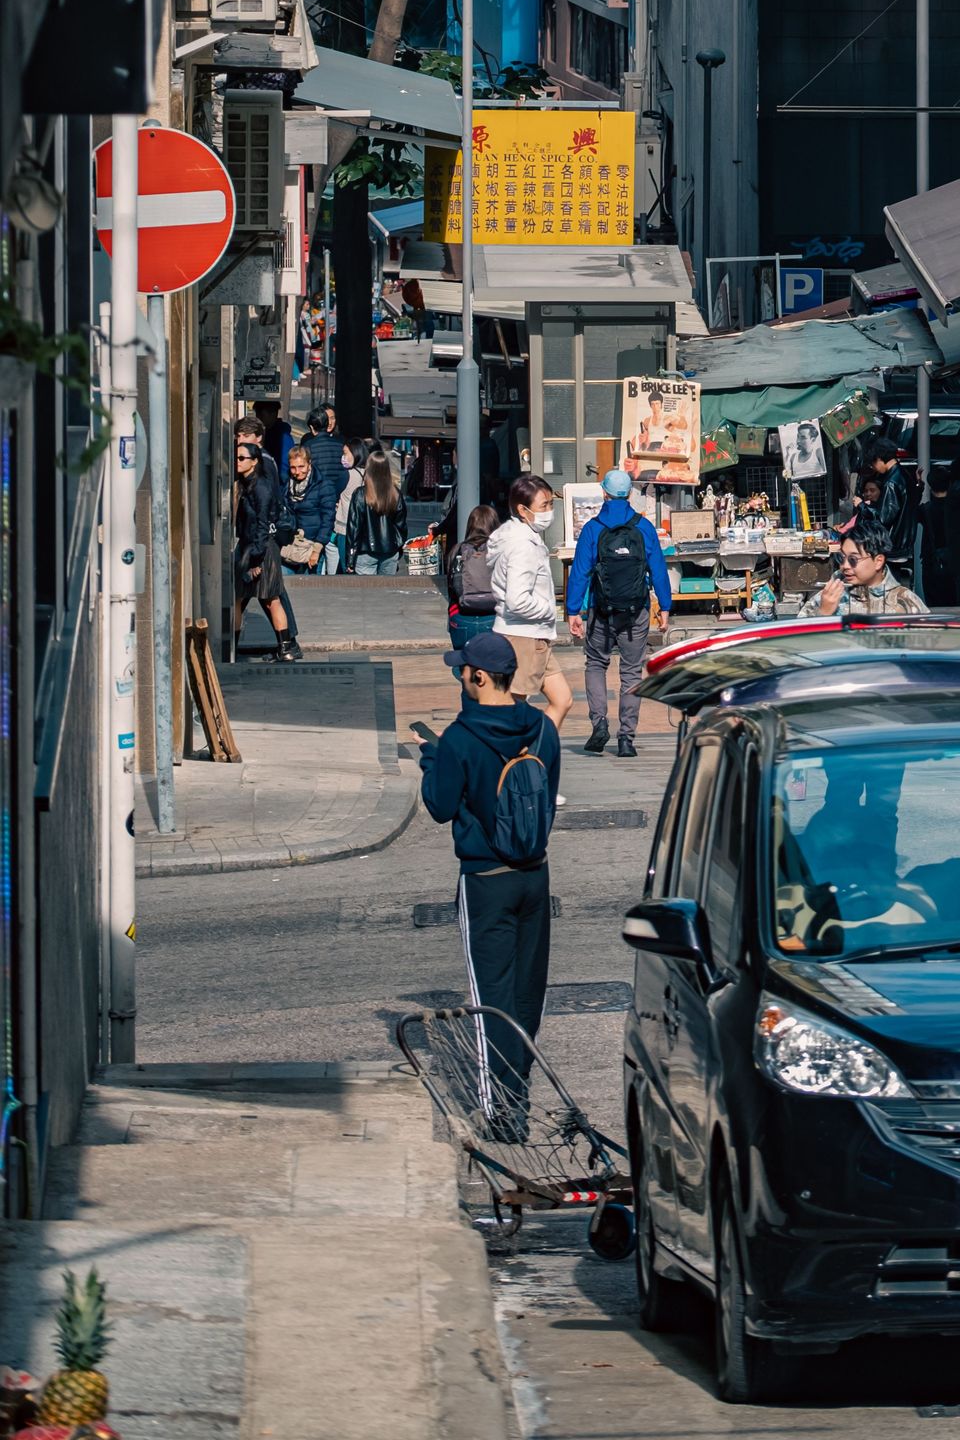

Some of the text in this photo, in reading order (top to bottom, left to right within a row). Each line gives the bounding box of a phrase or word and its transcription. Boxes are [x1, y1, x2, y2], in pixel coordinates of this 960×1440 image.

[567, 127, 599, 155] 興
[472, 154, 598, 163] UAN HENG SPICE CO.
[785, 273, 814, 309] P
[641, 382, 671, 394] BRUCE
[672, 383, 688, 395] LEE
